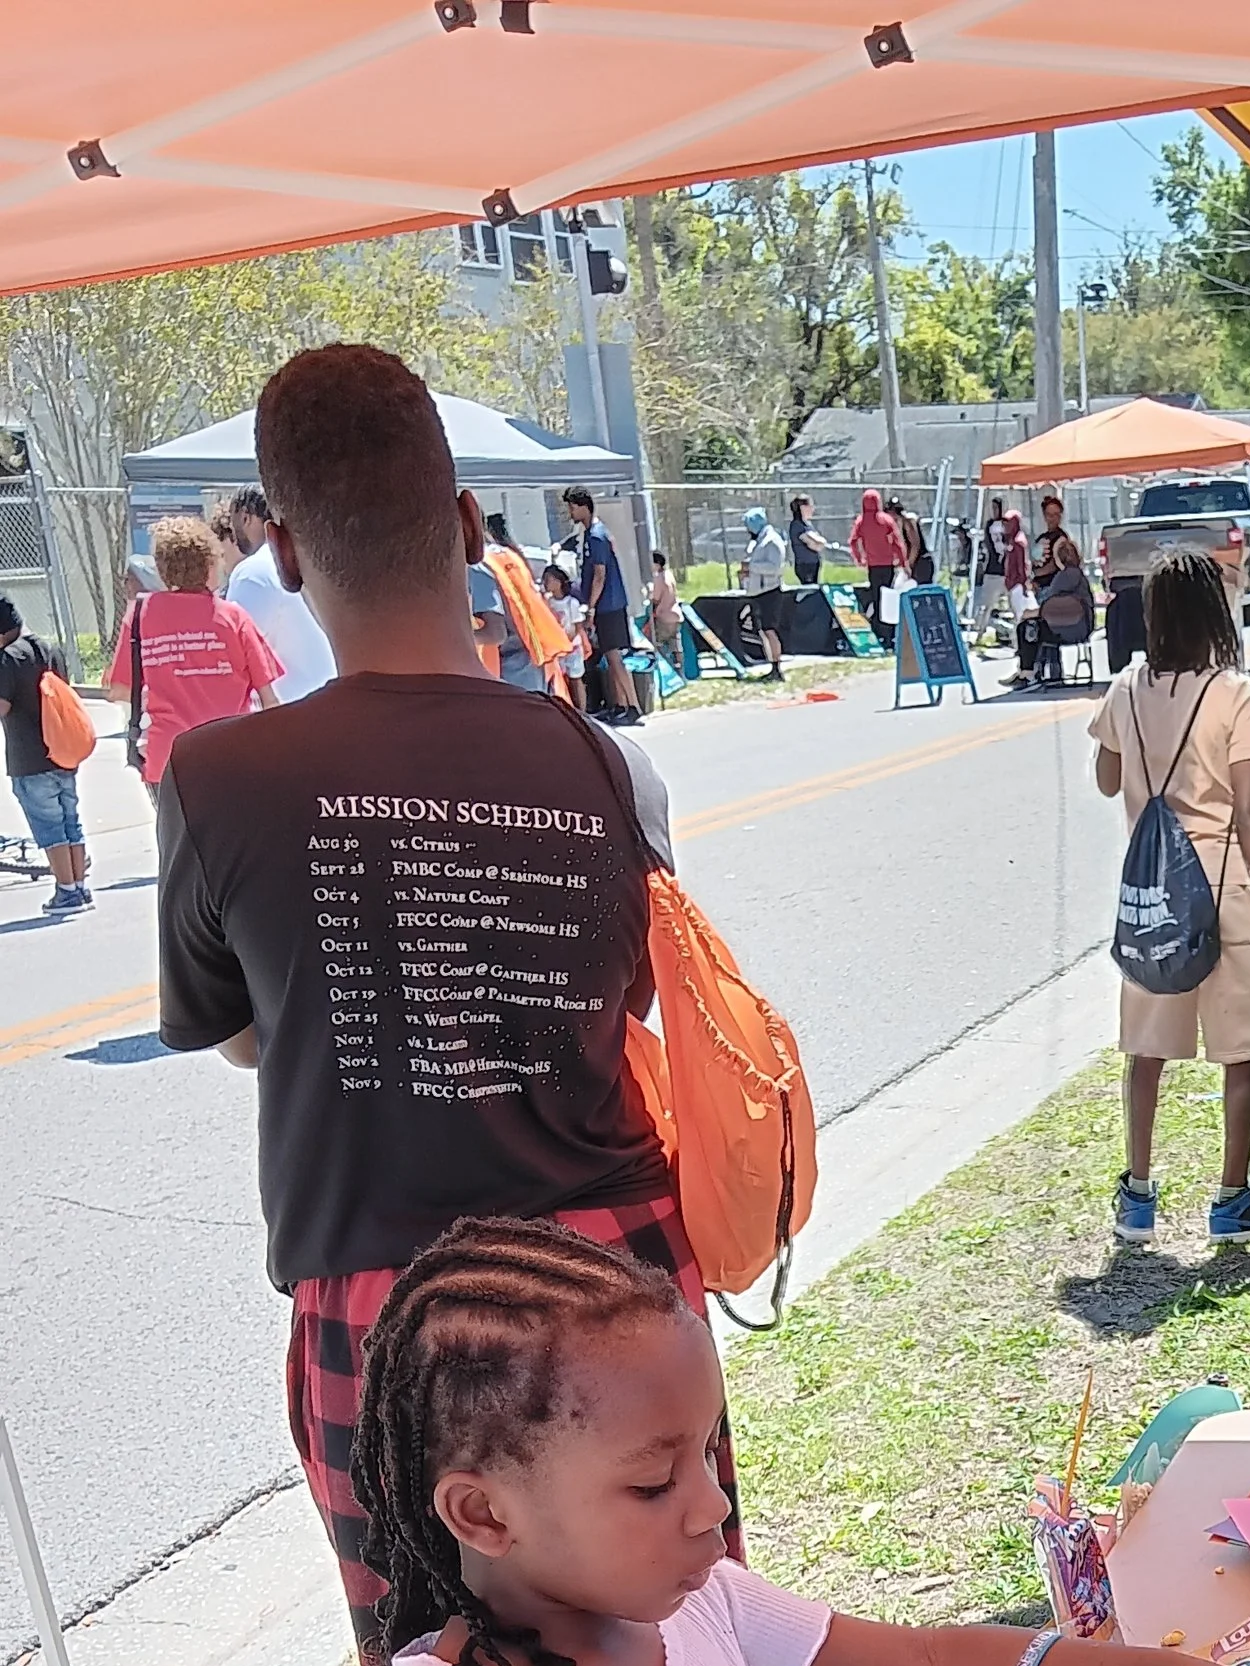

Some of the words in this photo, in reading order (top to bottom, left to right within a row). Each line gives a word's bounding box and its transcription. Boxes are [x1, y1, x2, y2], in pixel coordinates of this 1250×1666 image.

[317, 795, 450, 821] MISSION
[456, 801, 606, 838] SCHEDULE
[343, 838, 359, 852] 30
[349, 862, 365, 875] 28
[392, 860, 441, 877] FMBC
[485, 865, 498, 879] @
[566, 874, 588, 890] HS
[349, 891, 360, 904] 4
[352, 916, 360, 930] 5
[396, 912, 438, 927] FFCC
[480, 915, 494, 930] @
[558, 923, 580, 938] HS
[356, 941, 369, 951] 11
[358, 965, 374, 976] 12
[400, 962, 438, 978] FFCC
[475, 962, 489, 977] @
[549, 971, 570, 986] HS
[362, 989, 377, 1001] 19
[474, 985, 486, 1000] @
[588, 998, 604, 1012] HS
[363, 1012, 379, 1025] 25
[410, 1057, 443, 1075] FBA
[534, 1060, 552, 1075] HS
[373, 1078, 382, 1090] 9
[411, 1081, 454, 1099] FFCC
